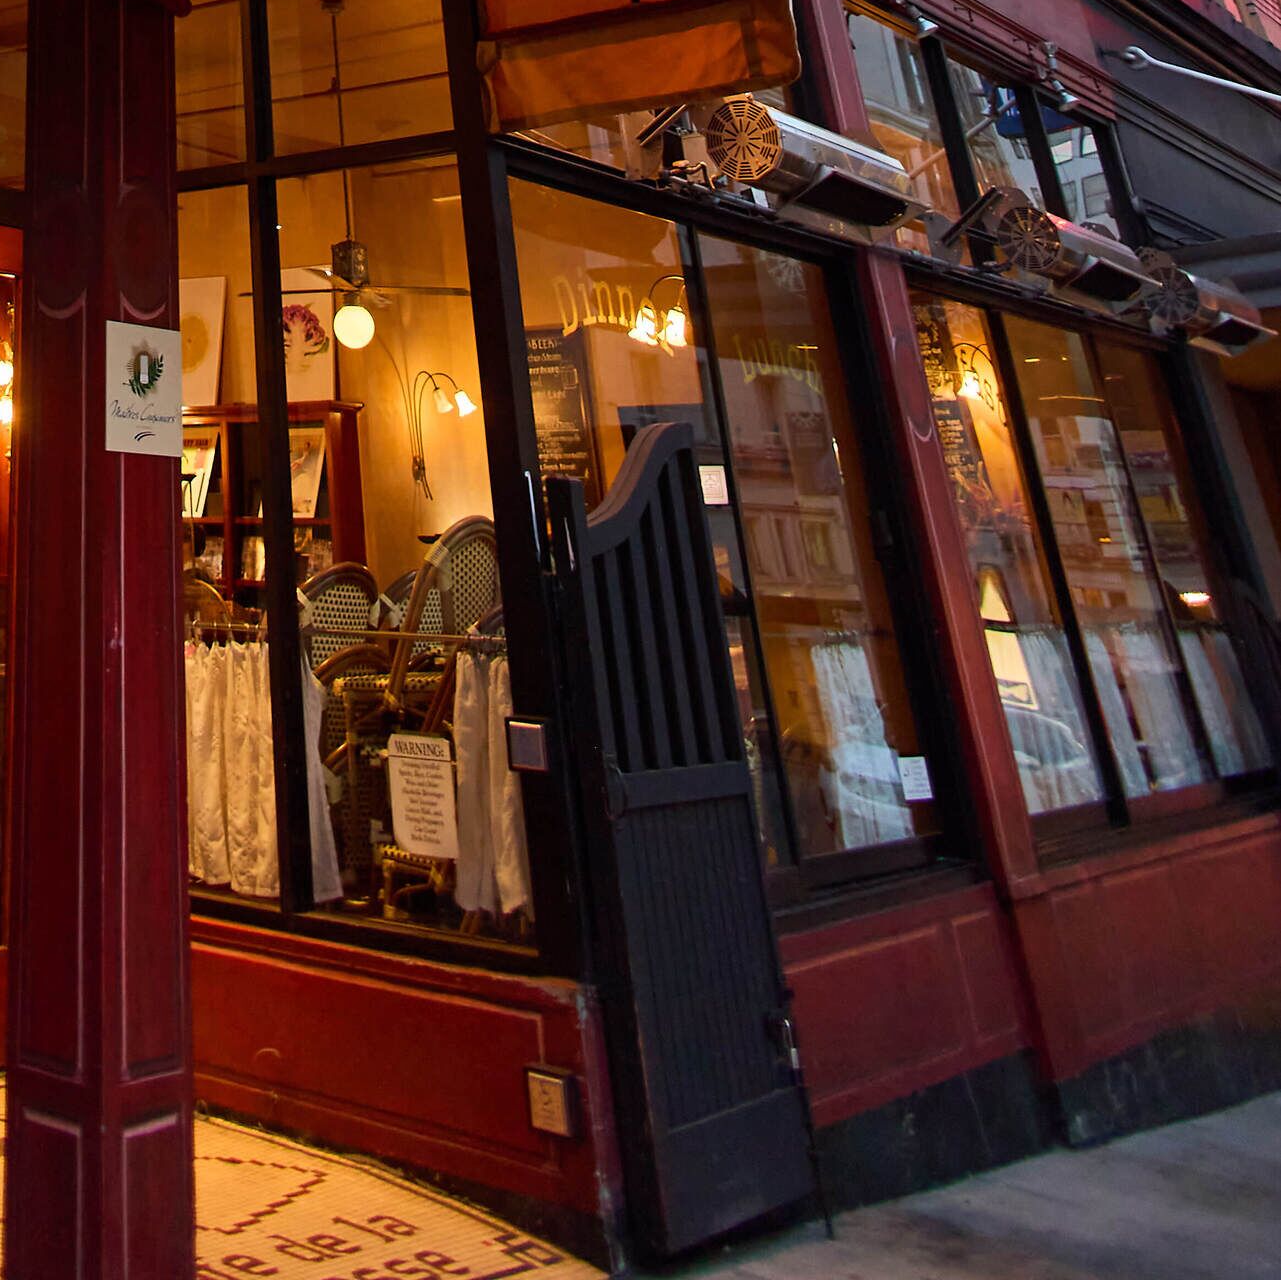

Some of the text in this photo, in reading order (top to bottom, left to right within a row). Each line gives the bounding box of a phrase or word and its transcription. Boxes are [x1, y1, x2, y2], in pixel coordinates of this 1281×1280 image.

[553, 276, 676, 358] Dinner
[395, 740, 445, 758] WARNING:
[267, 1234, 363, 1263] de
[332, 1214, 420, 1244] la
